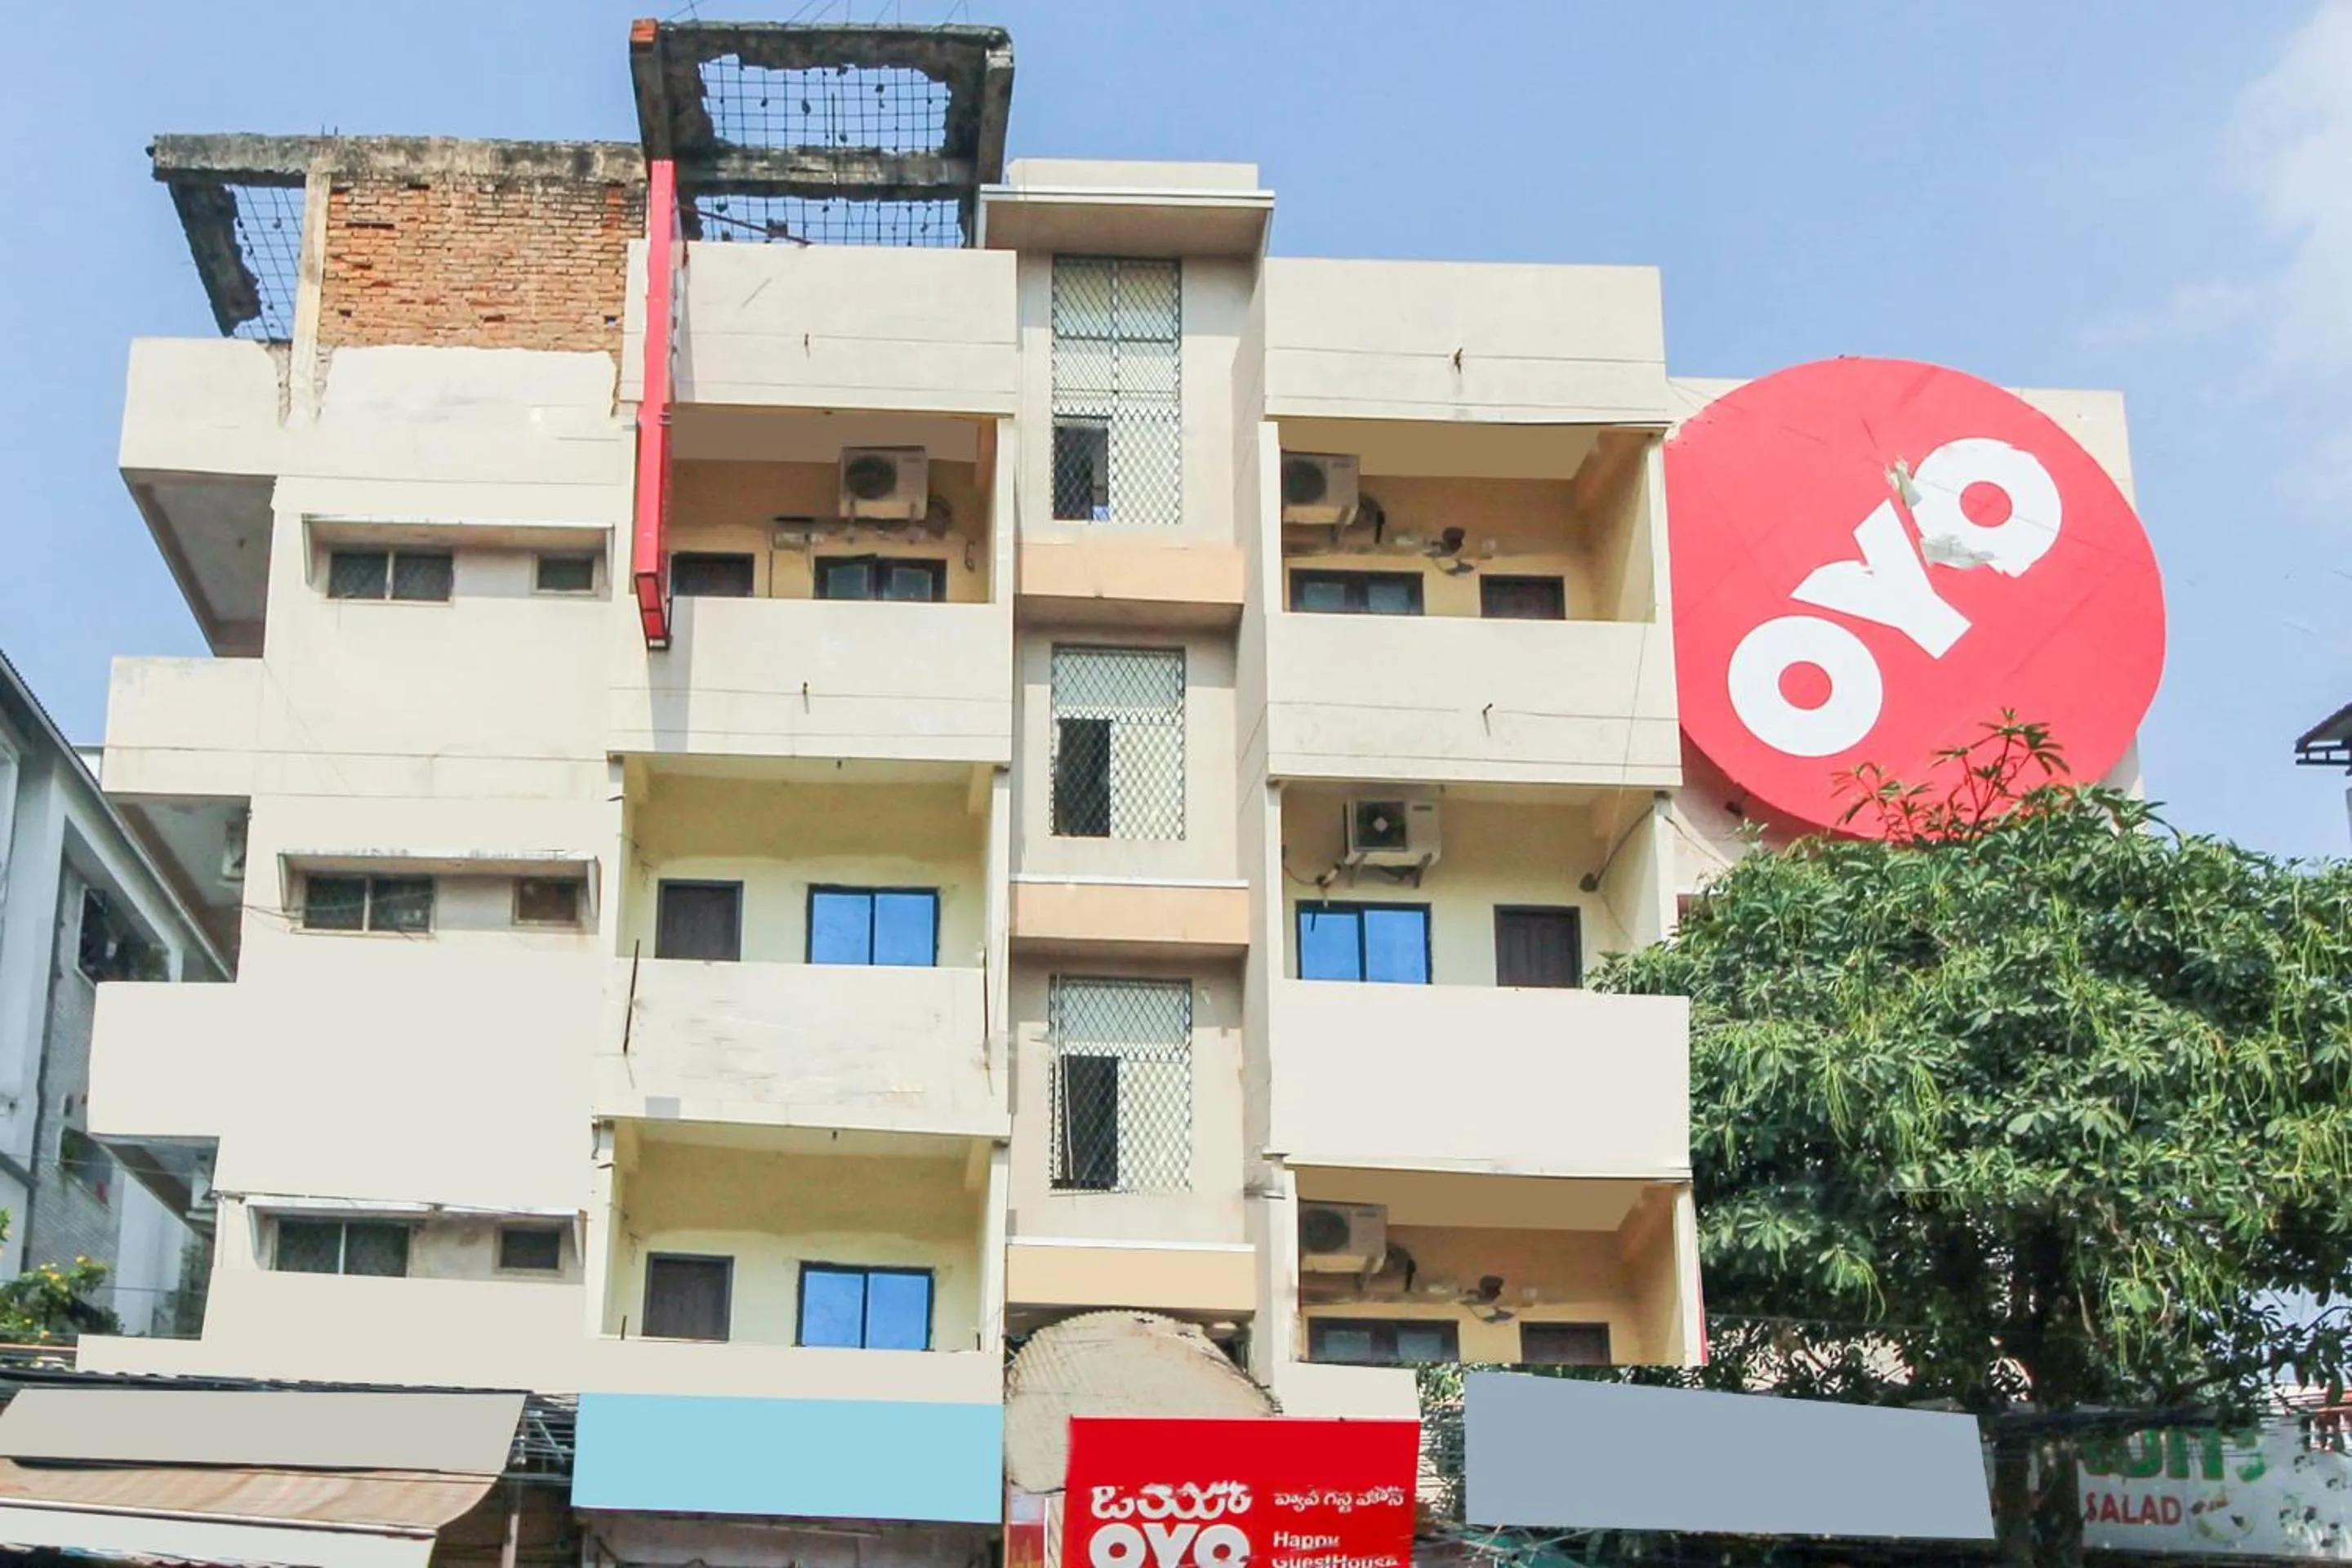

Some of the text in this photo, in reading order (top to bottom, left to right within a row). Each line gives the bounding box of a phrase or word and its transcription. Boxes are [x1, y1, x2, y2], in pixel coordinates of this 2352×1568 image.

[1728, 438, 2062, 756] OYO
[2086, 1491, 2183, 1526] SALAD
[1089, 1522, 1251, 1568] OYO
